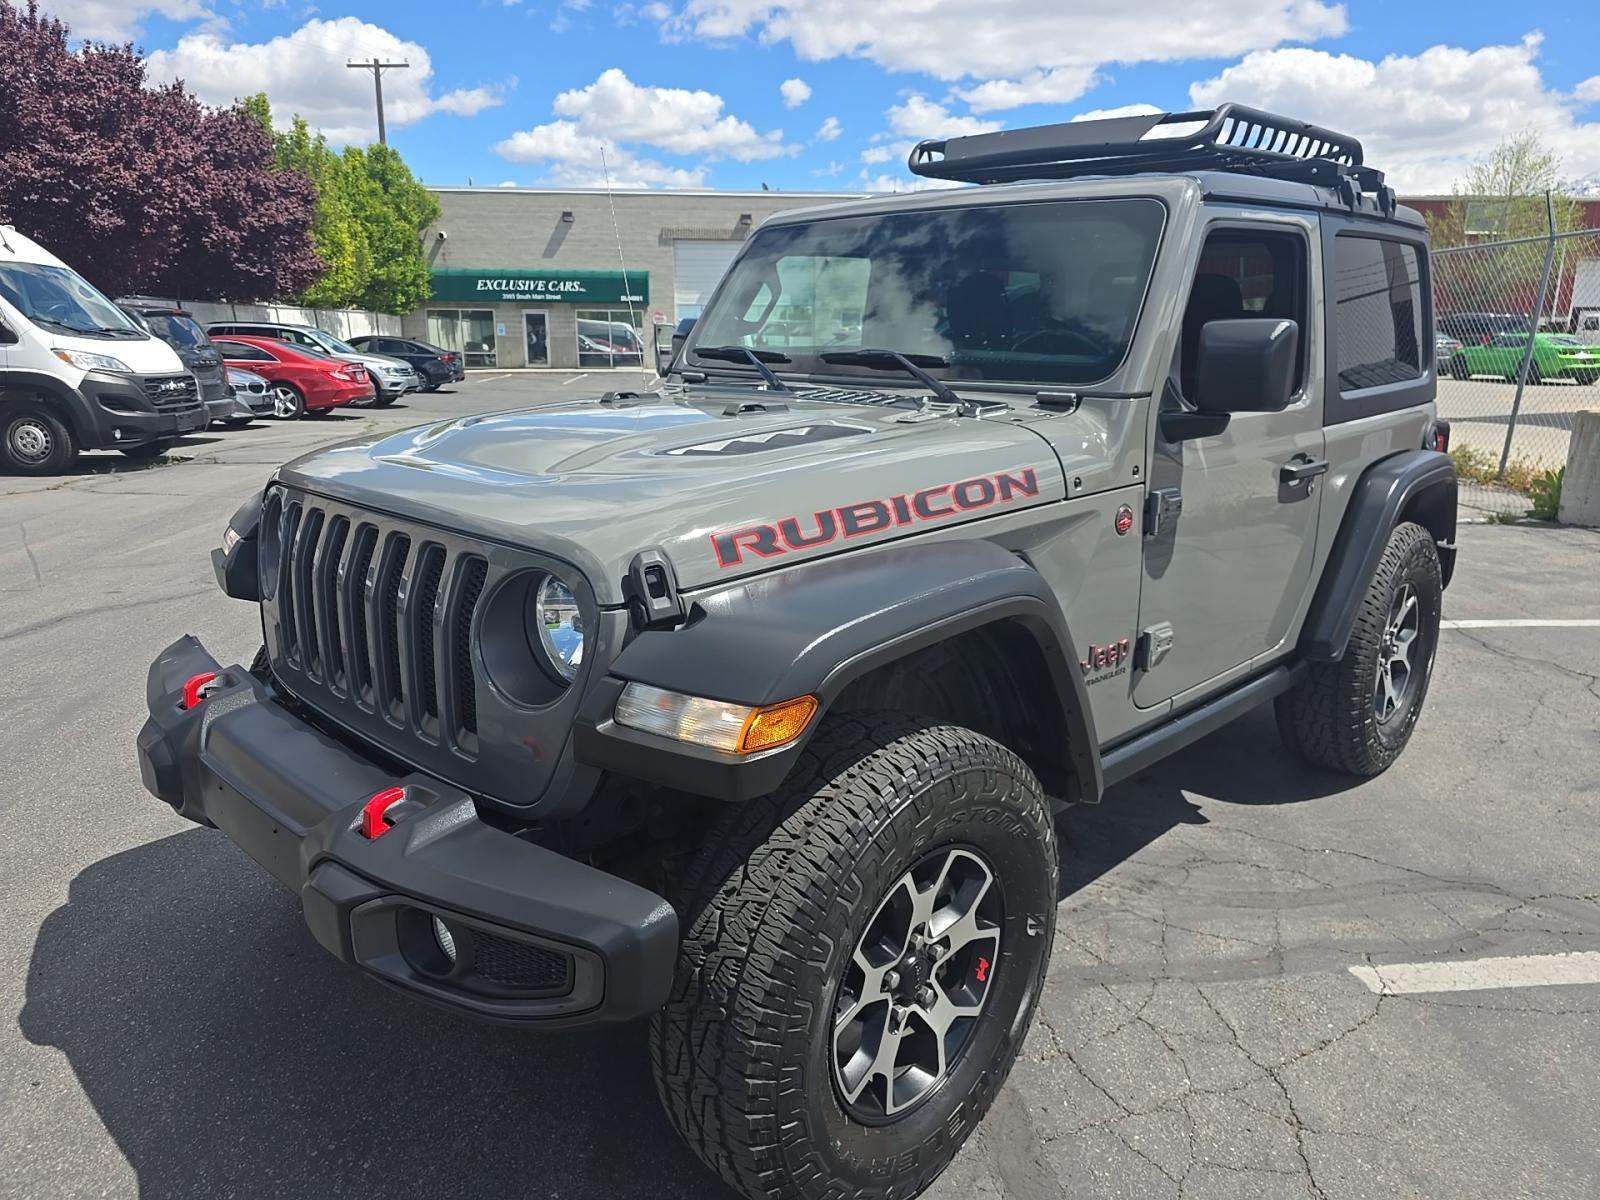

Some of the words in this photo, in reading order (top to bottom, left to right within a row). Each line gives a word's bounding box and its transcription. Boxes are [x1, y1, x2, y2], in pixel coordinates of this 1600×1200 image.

[476, 279, 546, 291] EXCLUSIVE
[548, 280, 580, 292] CARS
[710, 466, 1040, 569] RUBICON
[1080, 637, 1129, 675] Jeep
[1085, 666, 1126, 685] RANGLER
